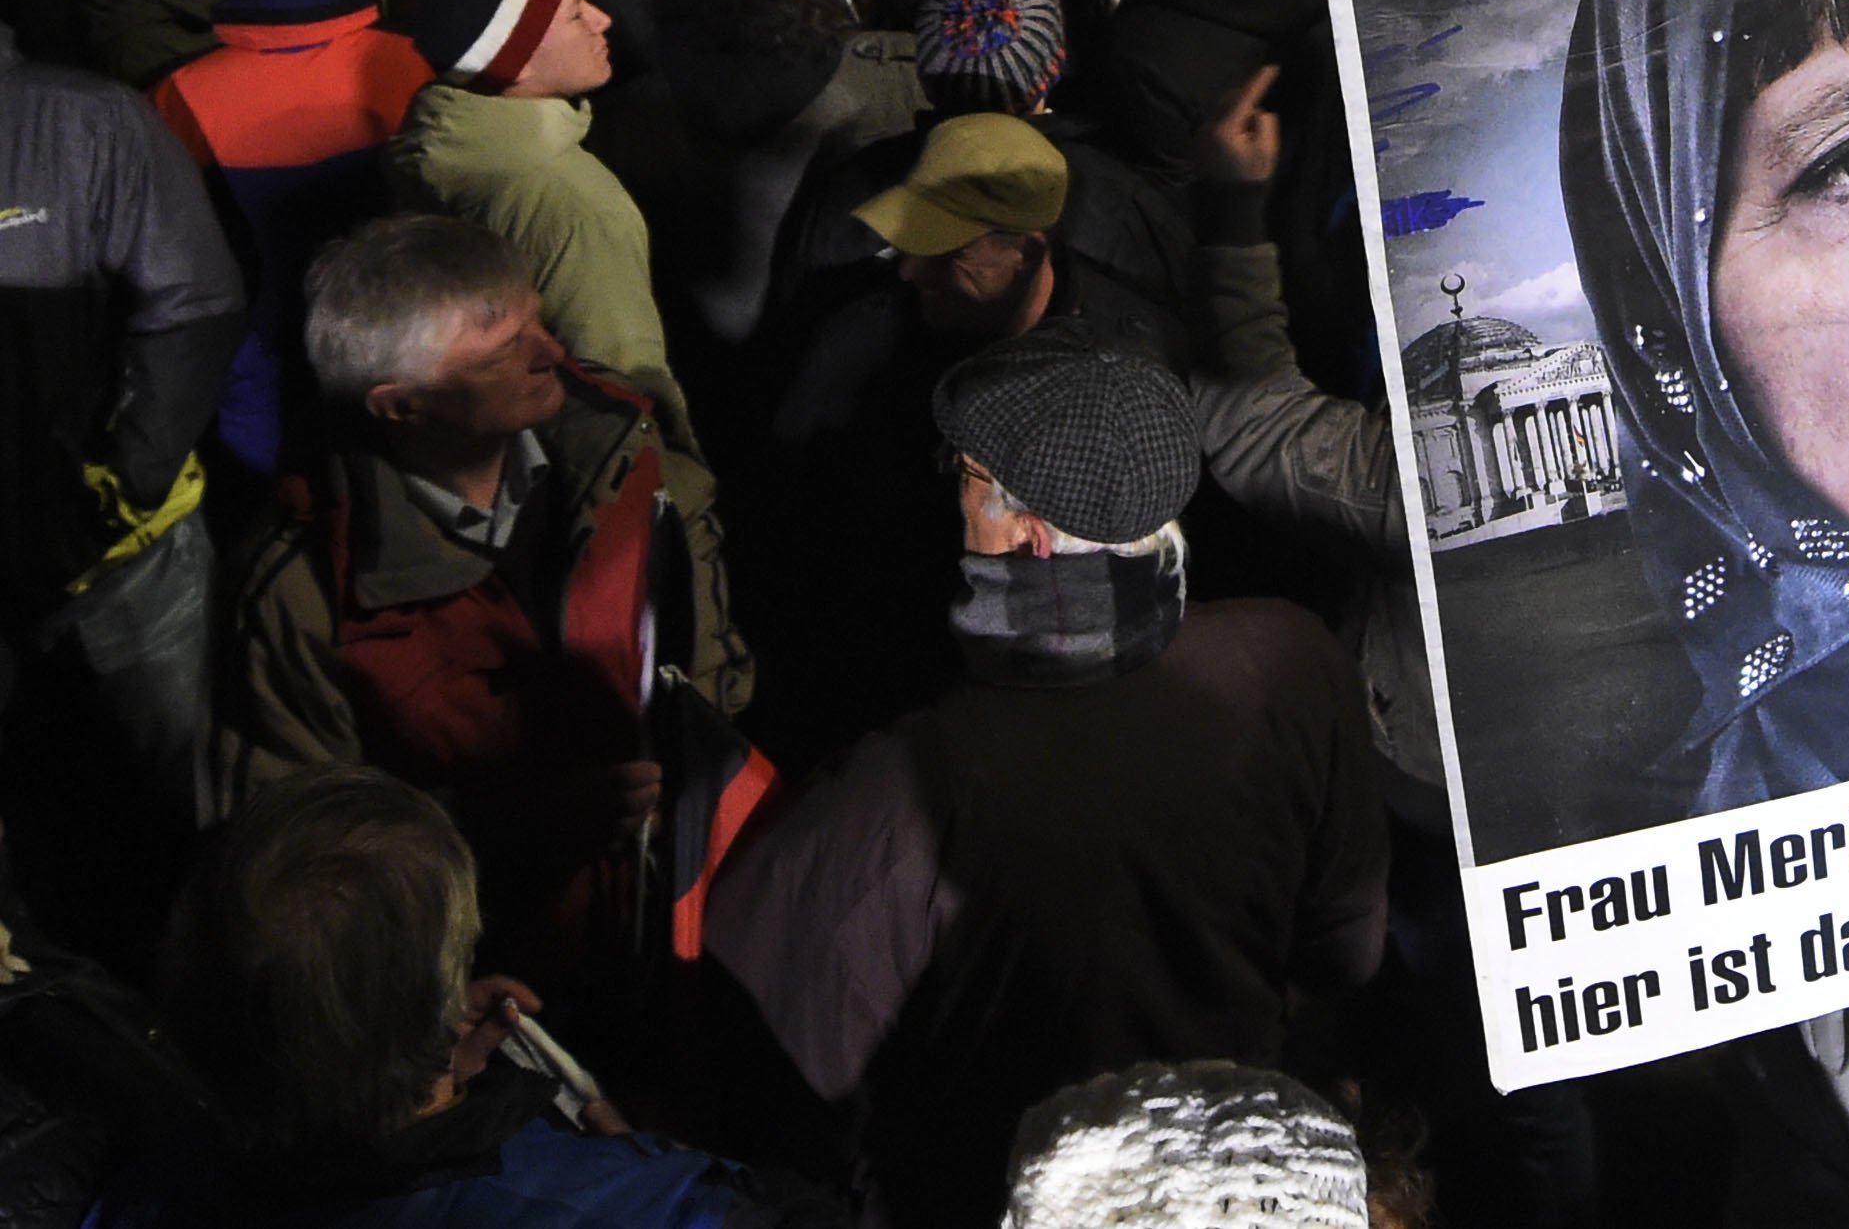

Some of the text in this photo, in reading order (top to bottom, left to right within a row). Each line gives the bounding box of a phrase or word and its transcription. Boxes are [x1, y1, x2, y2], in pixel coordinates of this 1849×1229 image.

[1502, 864, 1671, 951] Frau
[1514, 968, 1661, 1053] hier
[1688, 932, 1777, 1012] ist
